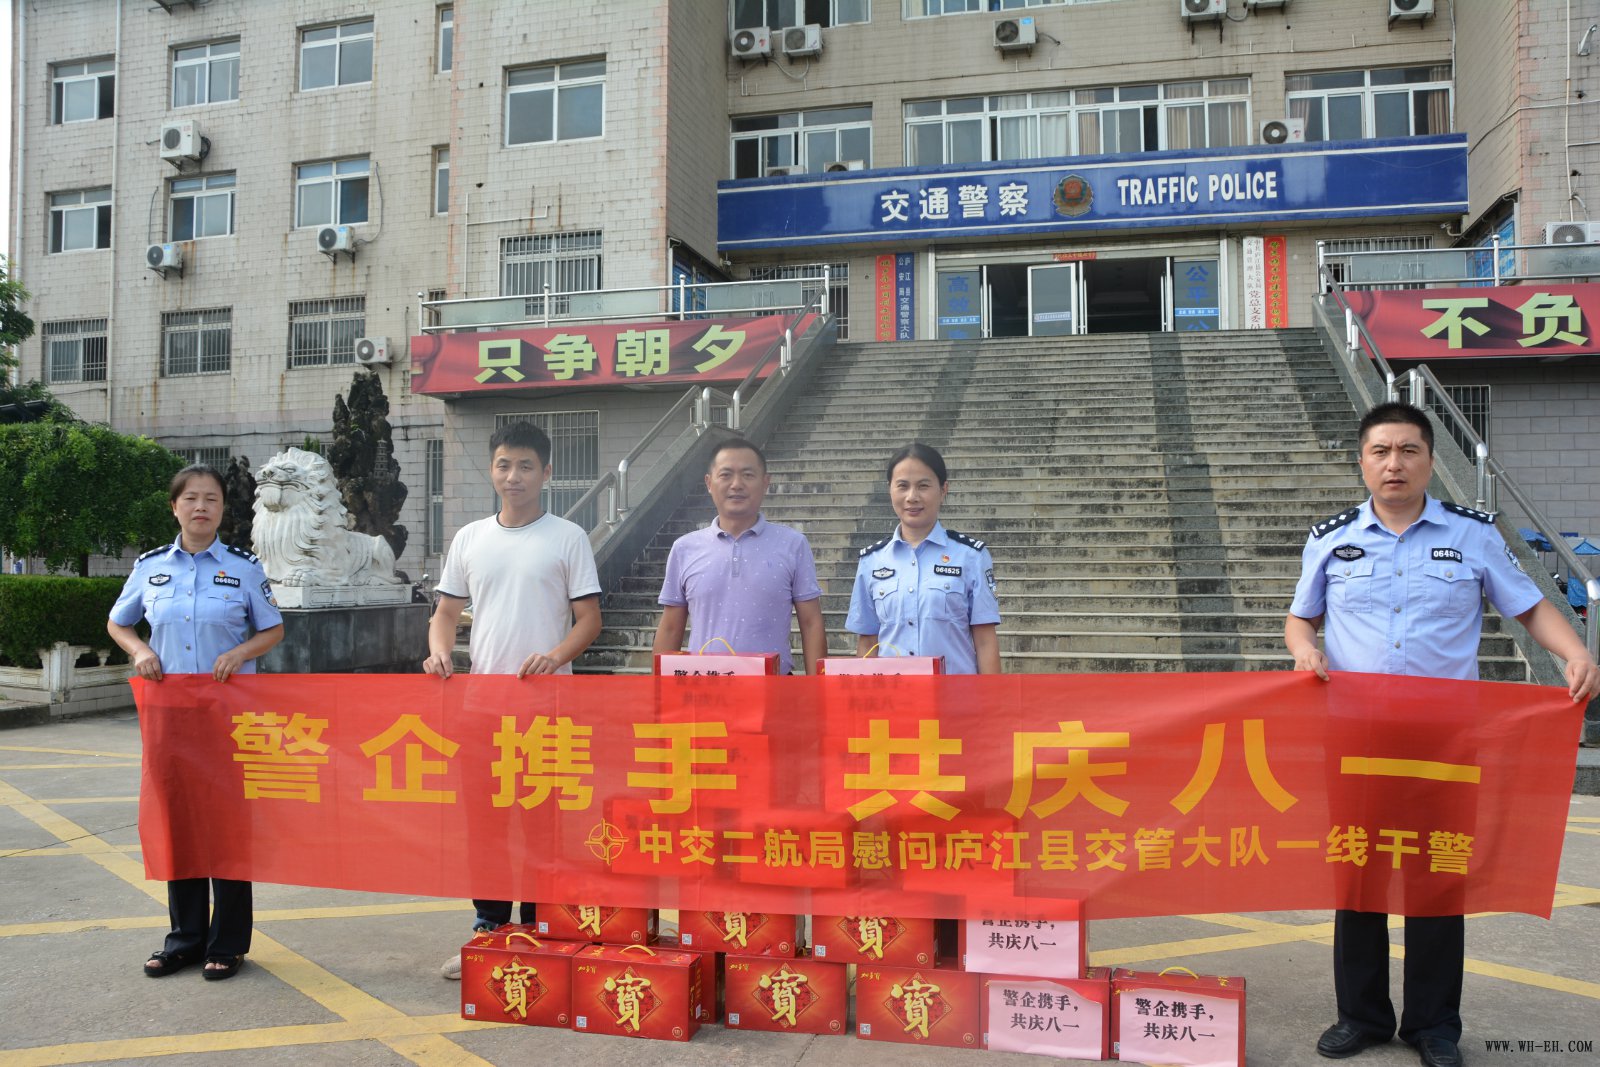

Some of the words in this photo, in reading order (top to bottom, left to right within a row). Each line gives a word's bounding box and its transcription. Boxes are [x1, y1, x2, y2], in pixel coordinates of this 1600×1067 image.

[880, 183, 1029, 223] 交通警察
[1118, 176, 1199, 206] TRAFFIC
[1209, 171, 1278, 201] POLICE
[1420, 293, 1589, 349] 不负
[473, 325, 746, 384] 只争朝夕
[935, 567, 960, 575] 064525
[230, 711, 737, 814] 警企携手
[844, 719, 1481, 821] 共庆八一
[639, 825, 1475, 875] 中交二航局慰问庐江县交管大队一线干警
[988, 932, 1057, 951] 共庆八一
[1010, 1013, 1080, 1033] 共庆八一
[1143, 1022, 1216, 1042] 共庆八一
